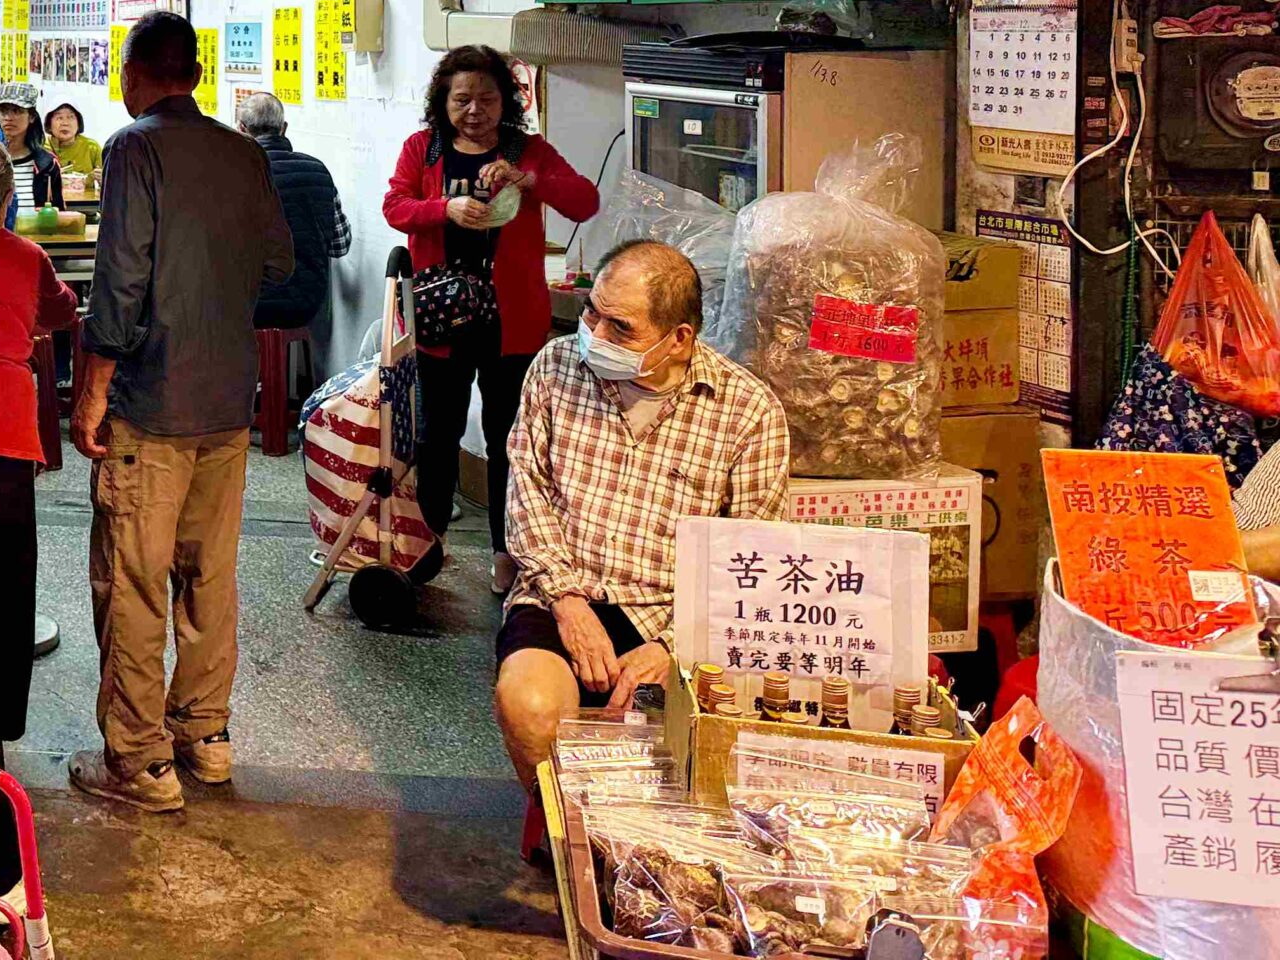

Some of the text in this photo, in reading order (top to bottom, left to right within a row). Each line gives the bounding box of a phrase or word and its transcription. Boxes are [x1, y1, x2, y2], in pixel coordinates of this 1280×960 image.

[989, 33, 995, 41] 1
[1004, 34, 1010, 42] 2
[1019, 34, 1025, 42] 3
[1034, 33, 1041, 42] 4
[1050, 34, 1056, 42] 5
[975, 50, 1071, 61] 7 8 9 10 11 12 13
[972, 68, 1069, 80] 14 15 16 17 18 19 20
[972, 85, 980, 93] 21
[985, 86, 995, 95] 22
[999, 87, 1009, 95] 23
[1014, 87, 1024, 96] 24
[1029, 88, 1040, 97] 25
[1045, 89, 1055, 98] 26
[983, 104, 993, 112] 29
[998, 105, 1007, 113] 30
[1012, 105, 1023, 114] 31
[1062, 480, 1216, 520] 南投精選
[727, 551, 865, 596] 苦茶油
[726, 646, 871, 679] 賣完要等明年
[1156, 737, 1232, 777] 品質
[1158, 784, 1234, 825] 台灣
[1162, 833, 1238, 873] 產銷
